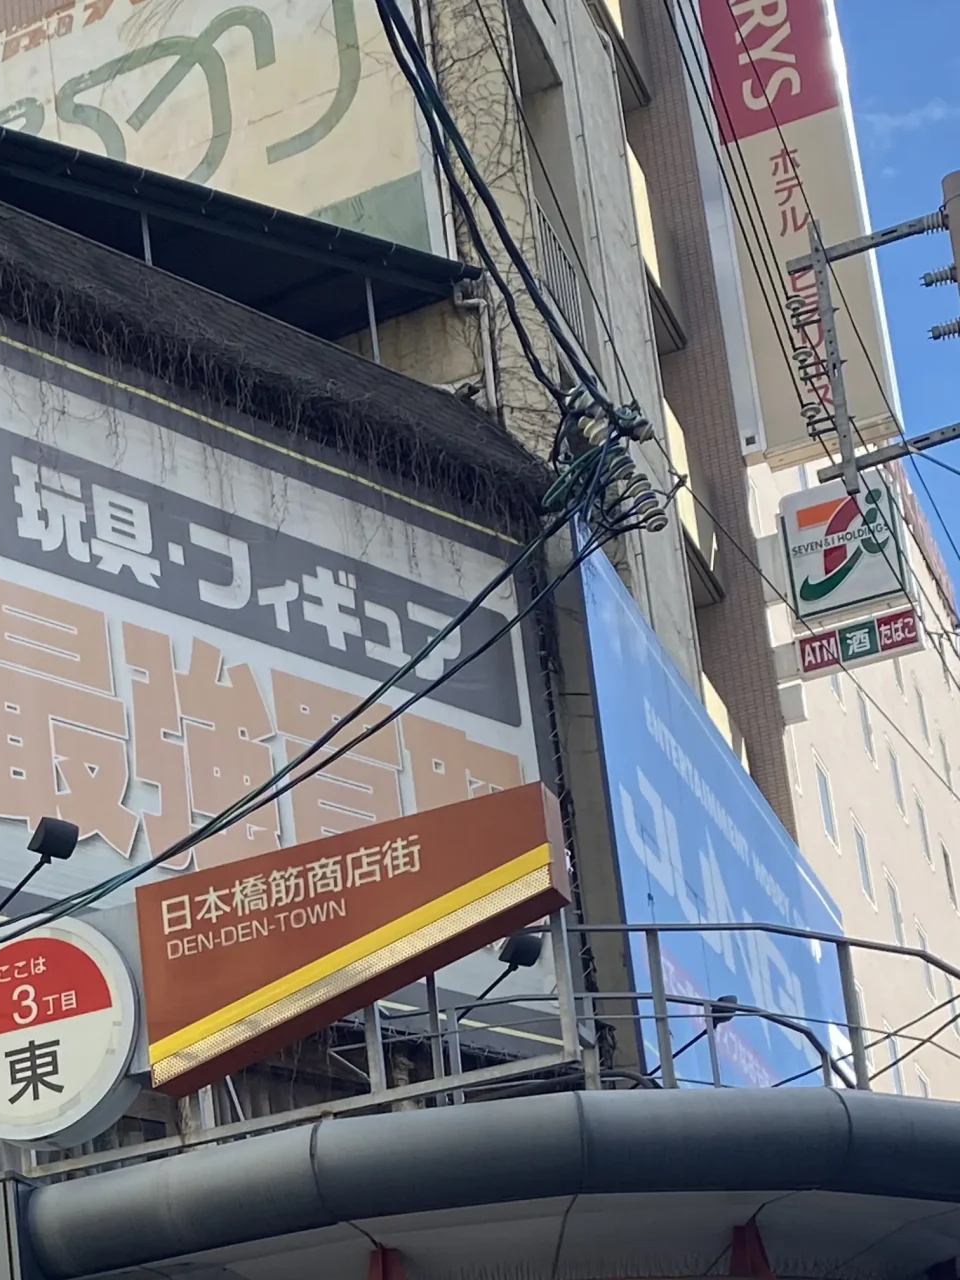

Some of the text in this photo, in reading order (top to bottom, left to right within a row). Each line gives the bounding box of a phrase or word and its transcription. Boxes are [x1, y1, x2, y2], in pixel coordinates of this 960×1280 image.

[769, 147, 810, 239] ホテル
[10, 453, 464, 682] 玩具・フィギュア
[804, 637, 838, 667] ATM
[845, 628, 871, 656] 酒
[879, 616, 917, 646] たばこ
[159, 832, 422, 936] 日本橋筋商店街
[166, 897, 347, 961] DEN-DEN-TOWN
[10, 984, 78, 1025] 3丁目
[4, 1040, 66, 1103] 東
